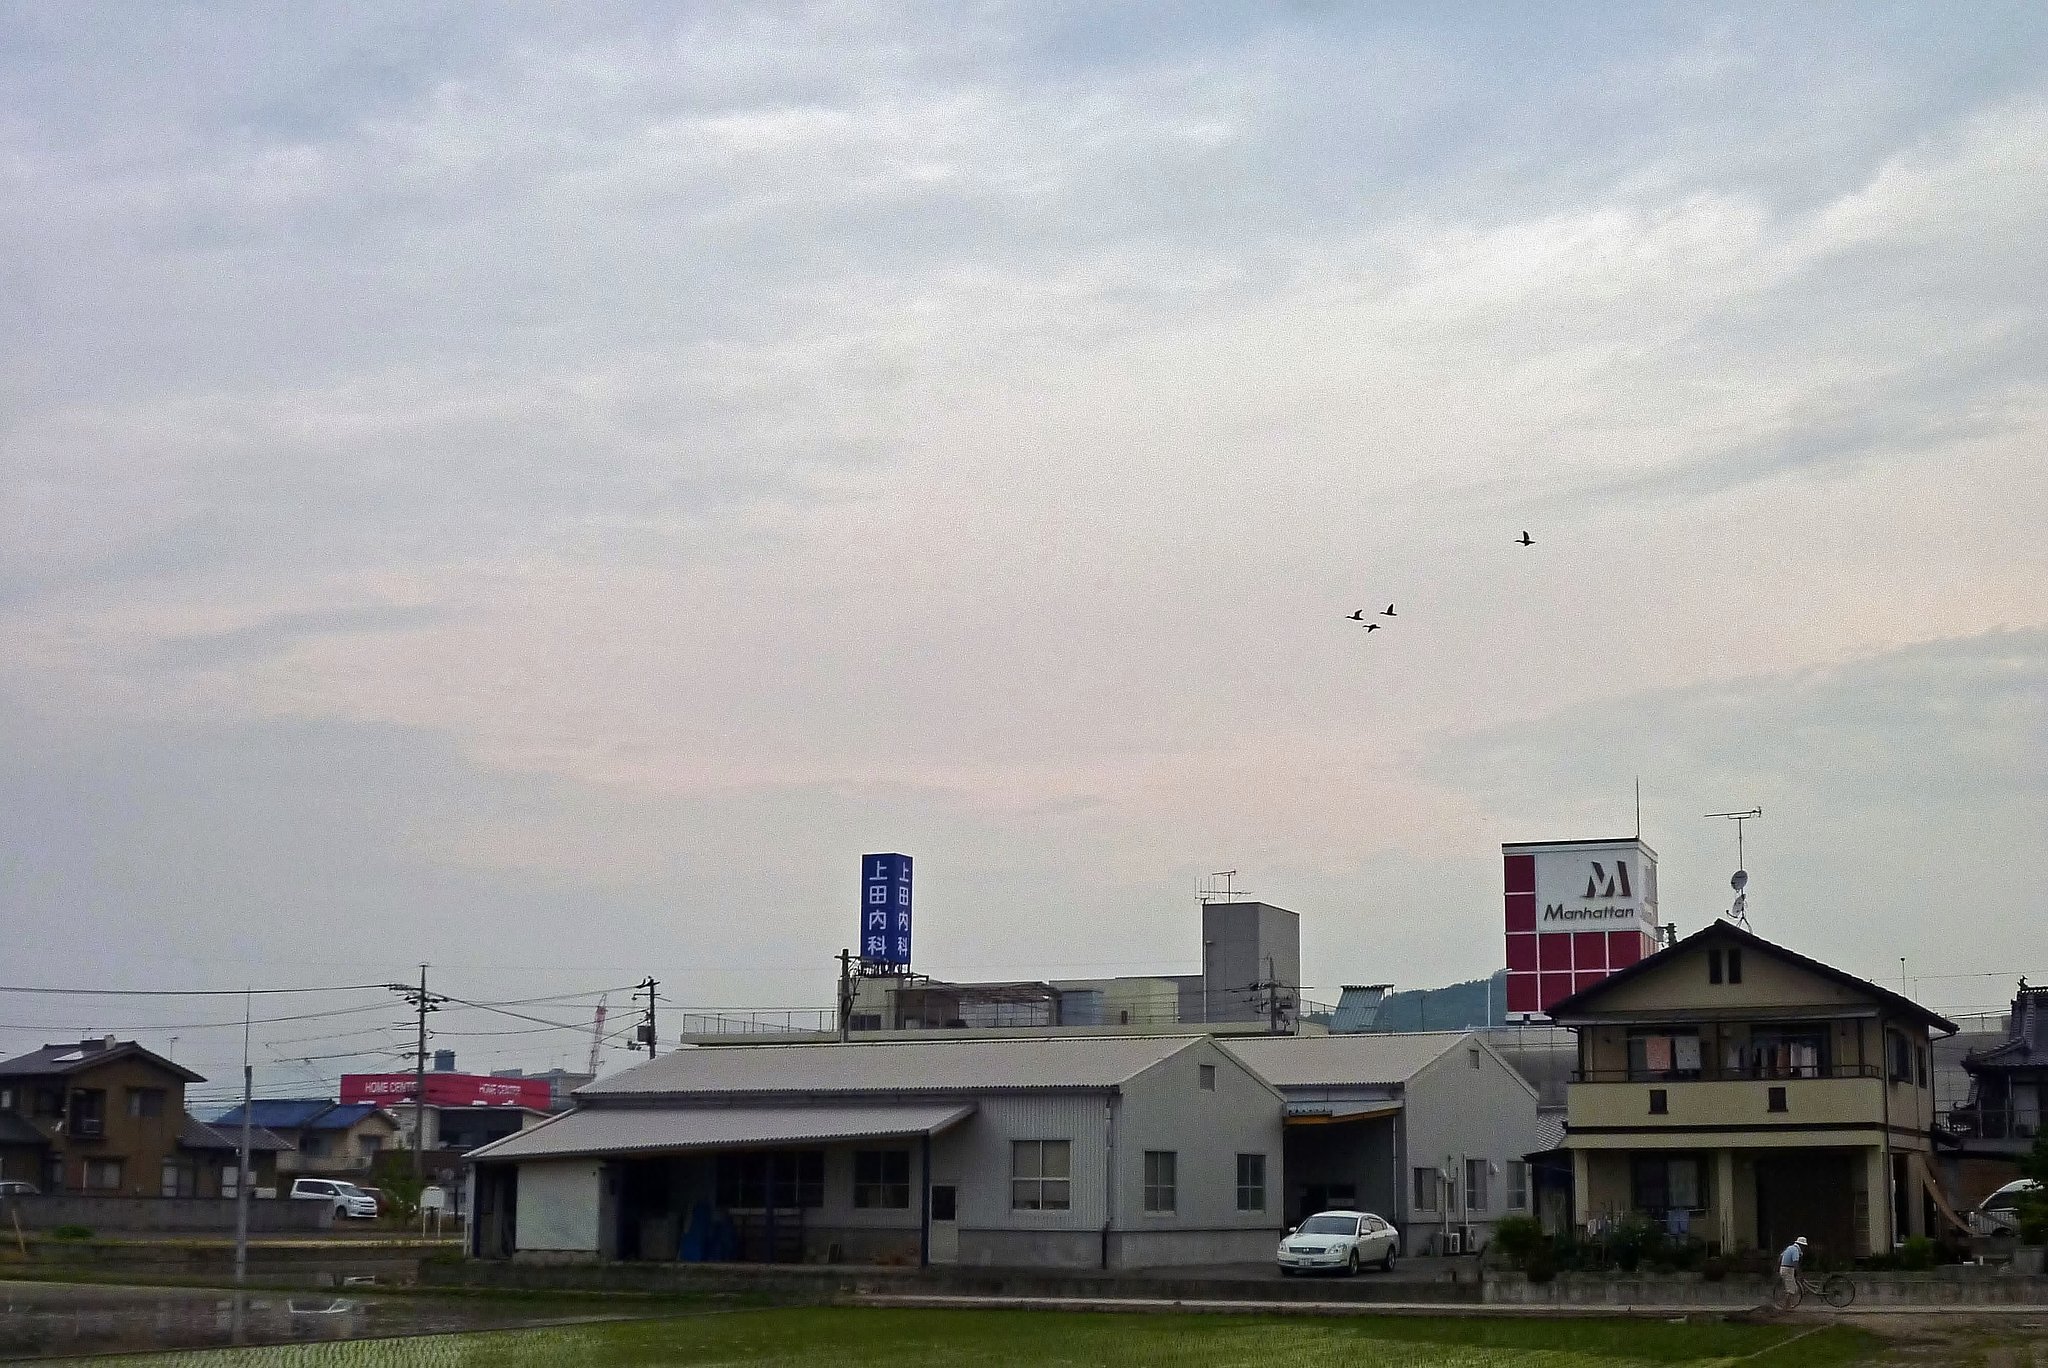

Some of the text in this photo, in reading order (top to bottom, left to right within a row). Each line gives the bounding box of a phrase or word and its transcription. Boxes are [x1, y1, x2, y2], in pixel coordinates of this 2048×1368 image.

[867, 860, 888, 956] 上田内科
[897, 861, 910, 957] 上田内科
[1543, 903, 1634, 922] Manhattan
[365, 1081, 417, 1093] HOME CENTE
